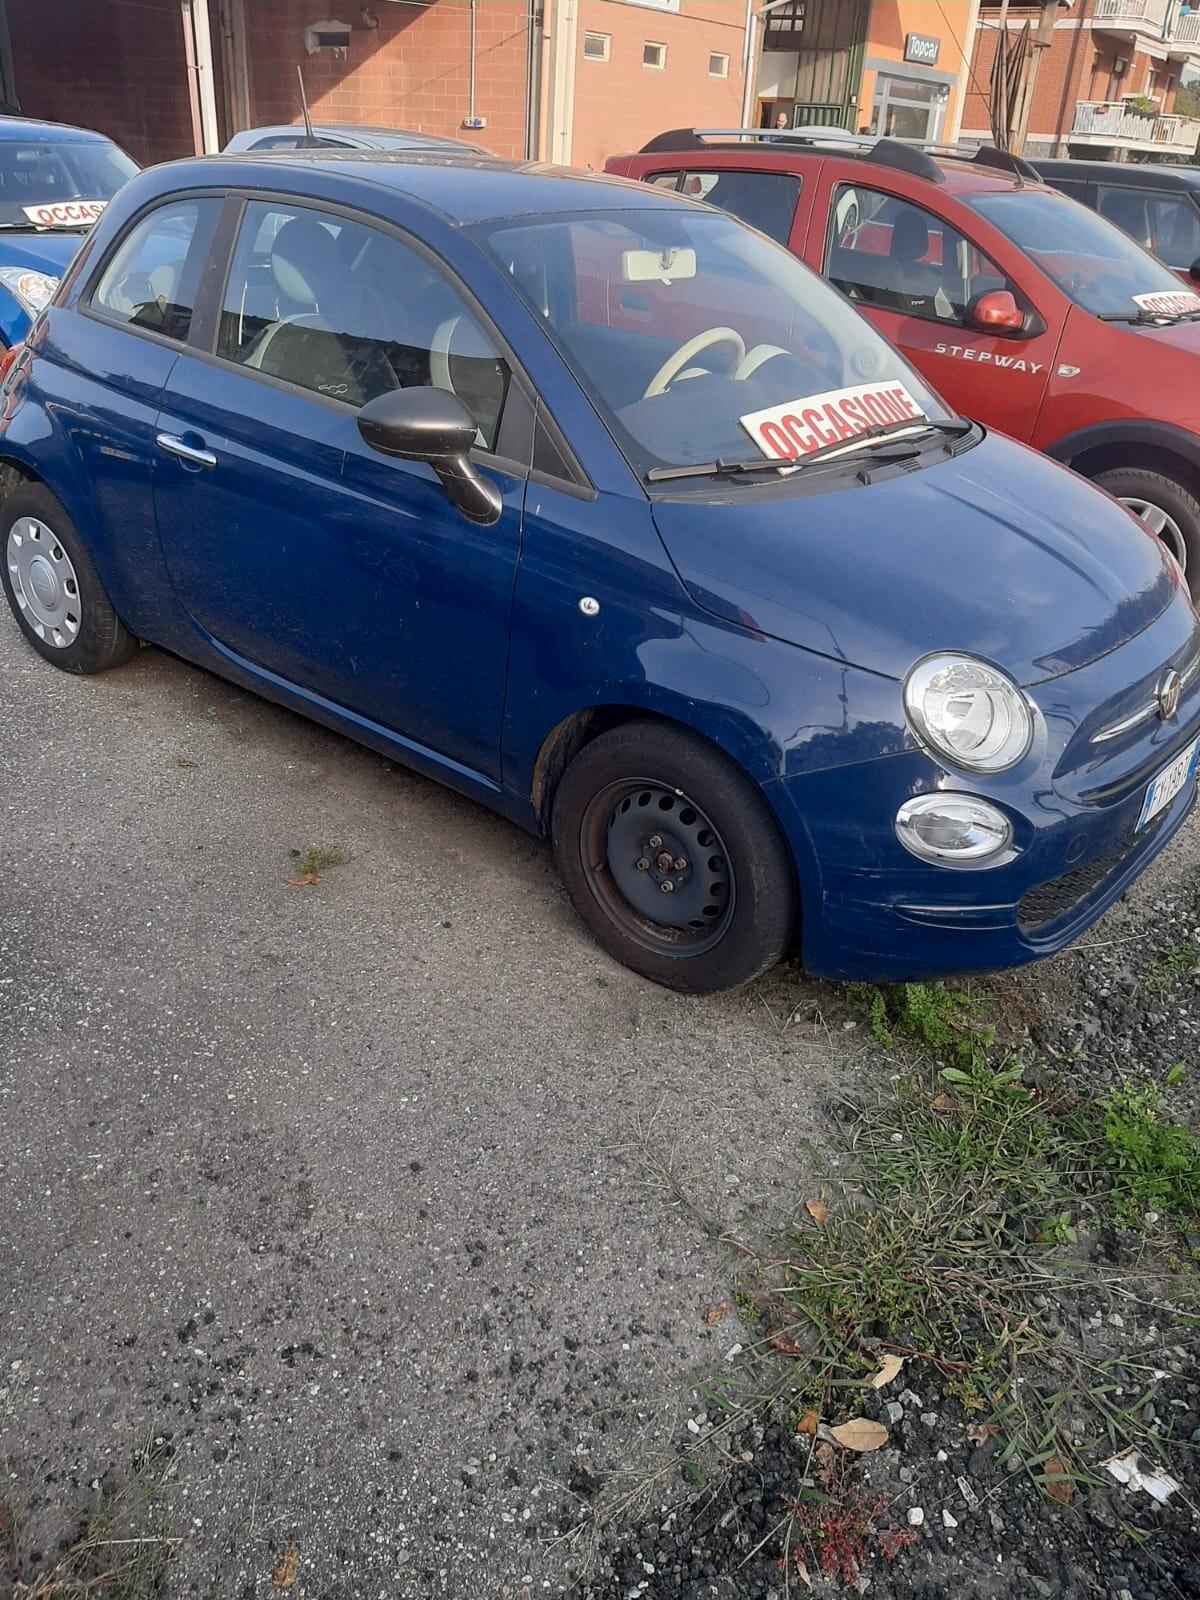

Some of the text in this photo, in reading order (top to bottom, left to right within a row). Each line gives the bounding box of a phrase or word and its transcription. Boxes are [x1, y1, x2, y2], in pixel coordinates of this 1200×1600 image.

[910, 35, 938, 59] Topcar
[37, 203, 104, 226] OCCAS
[934, 343, 1043, 374] STEPWAY
[759, 388, 914, 462] OCCASIONE
